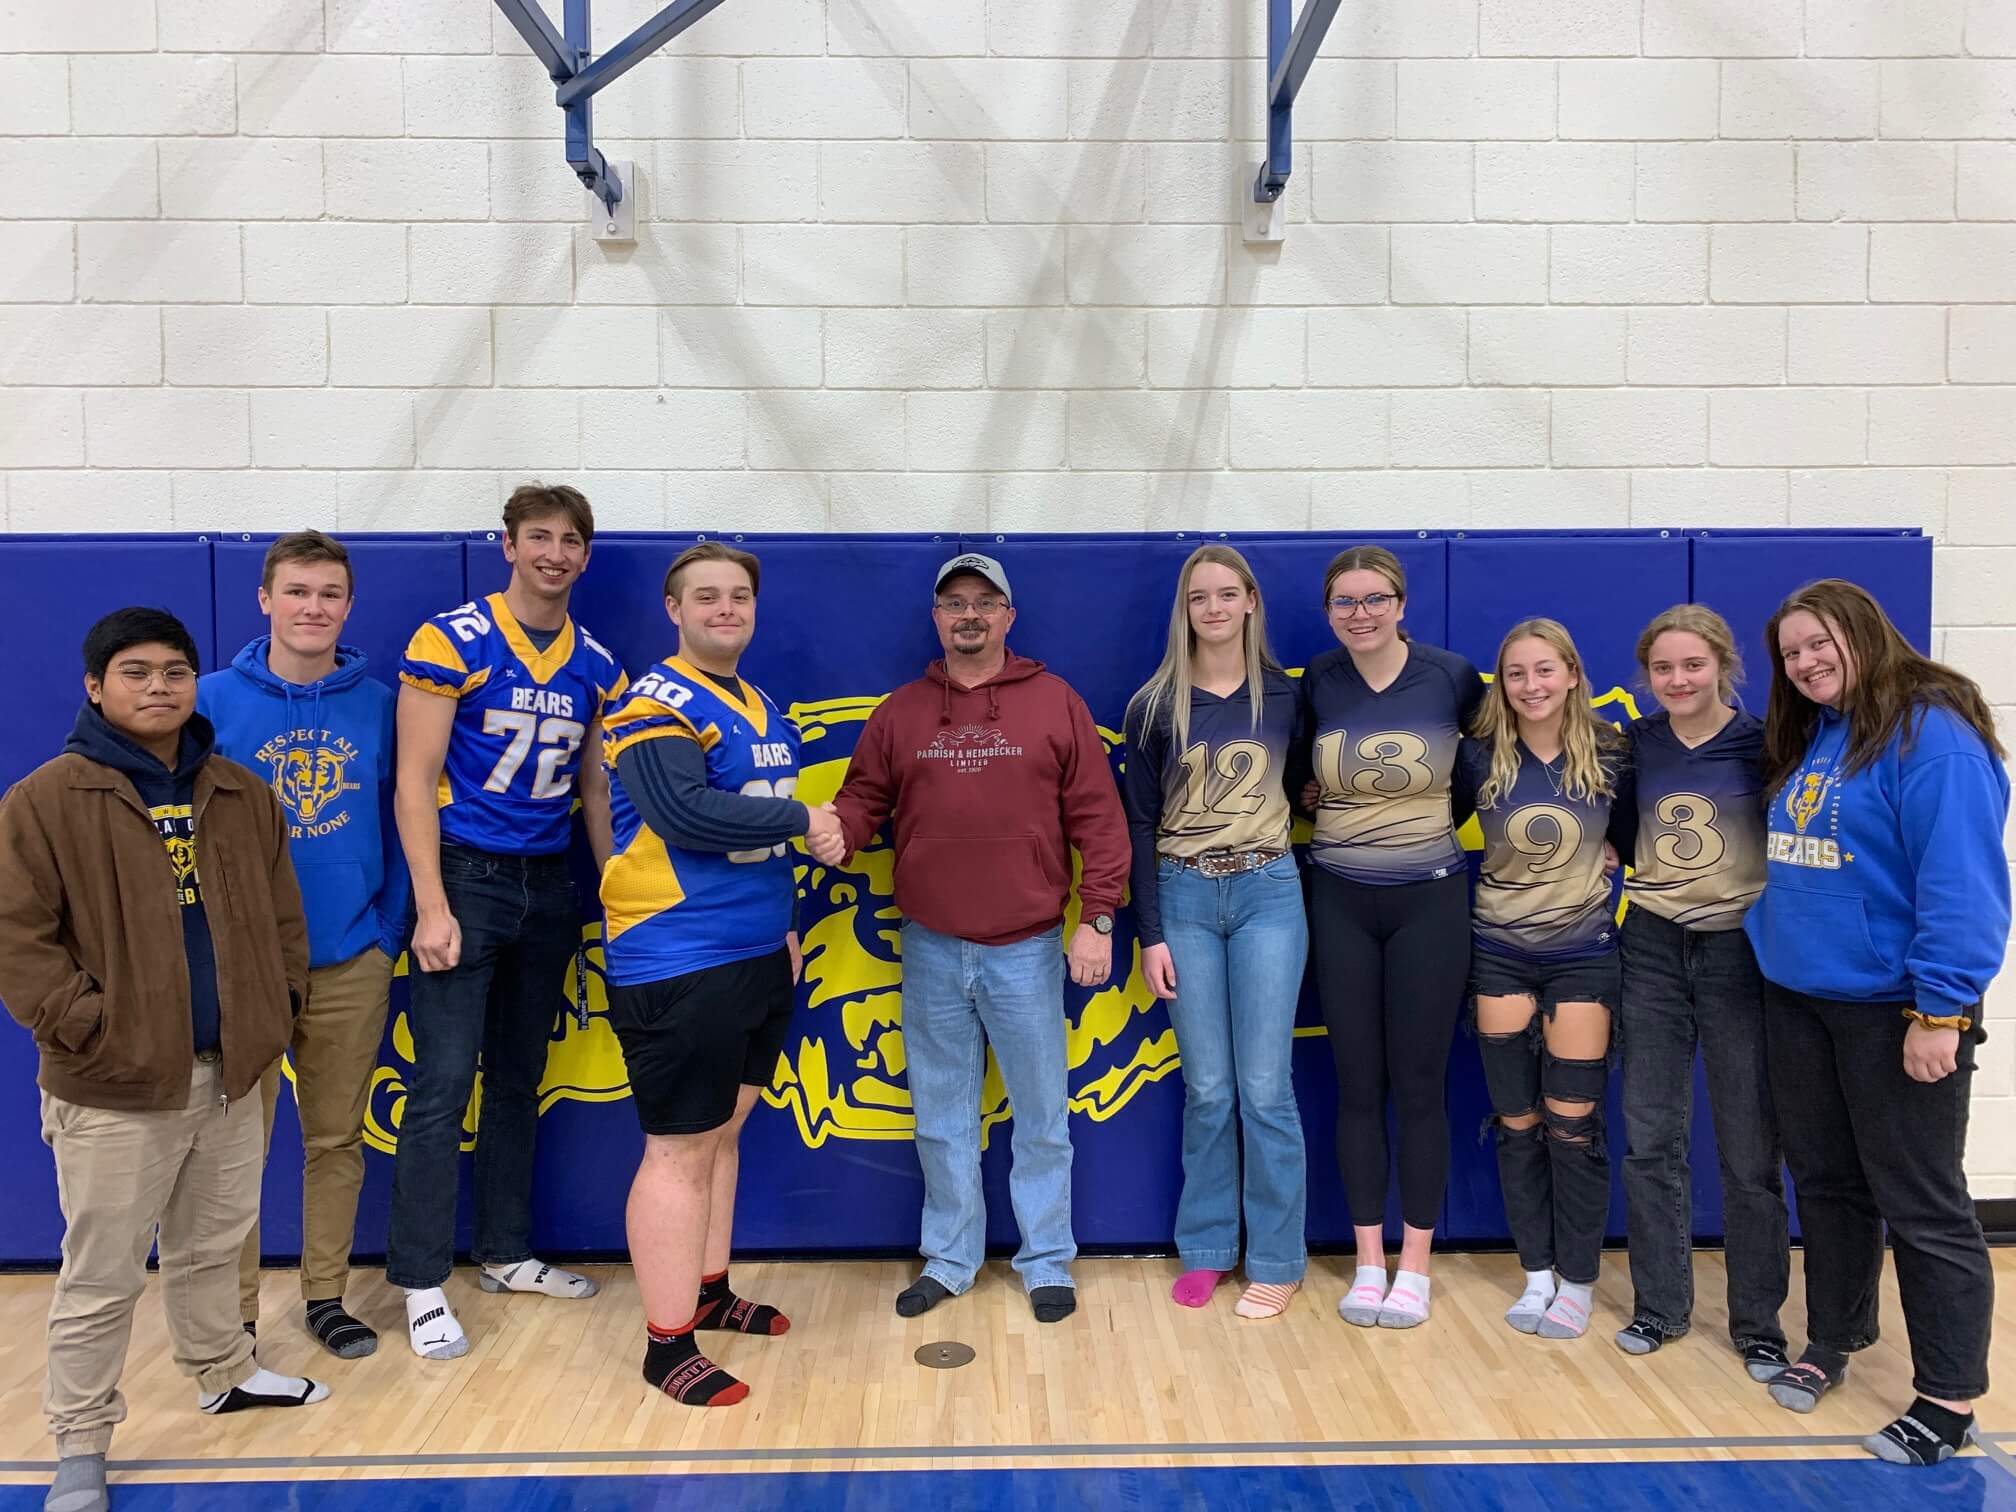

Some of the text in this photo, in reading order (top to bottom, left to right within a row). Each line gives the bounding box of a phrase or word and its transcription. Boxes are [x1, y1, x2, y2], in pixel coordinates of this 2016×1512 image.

[511, 687, 573, 718] BEARS
[255, 729, 359, 762] RESPECT ALL
[482, 708, 585, 799] 72
[917, 748, 954, 760] PARRISH
[966, 746, 1023, 759] HEIMBECKER
[950, 759, 988, 767] LIMITED
[1179, 740, 1270, 815] 12
[1316, 729, 1434, 799] 13
[306, 810, 350, 838] NONE
[1504, 803, 1584, 874] 9
[1655, 792, 1725, 871] 3
[1767, 831, 1841, 869] BEARS
[412, 1306, 445, 1332] PUMA
